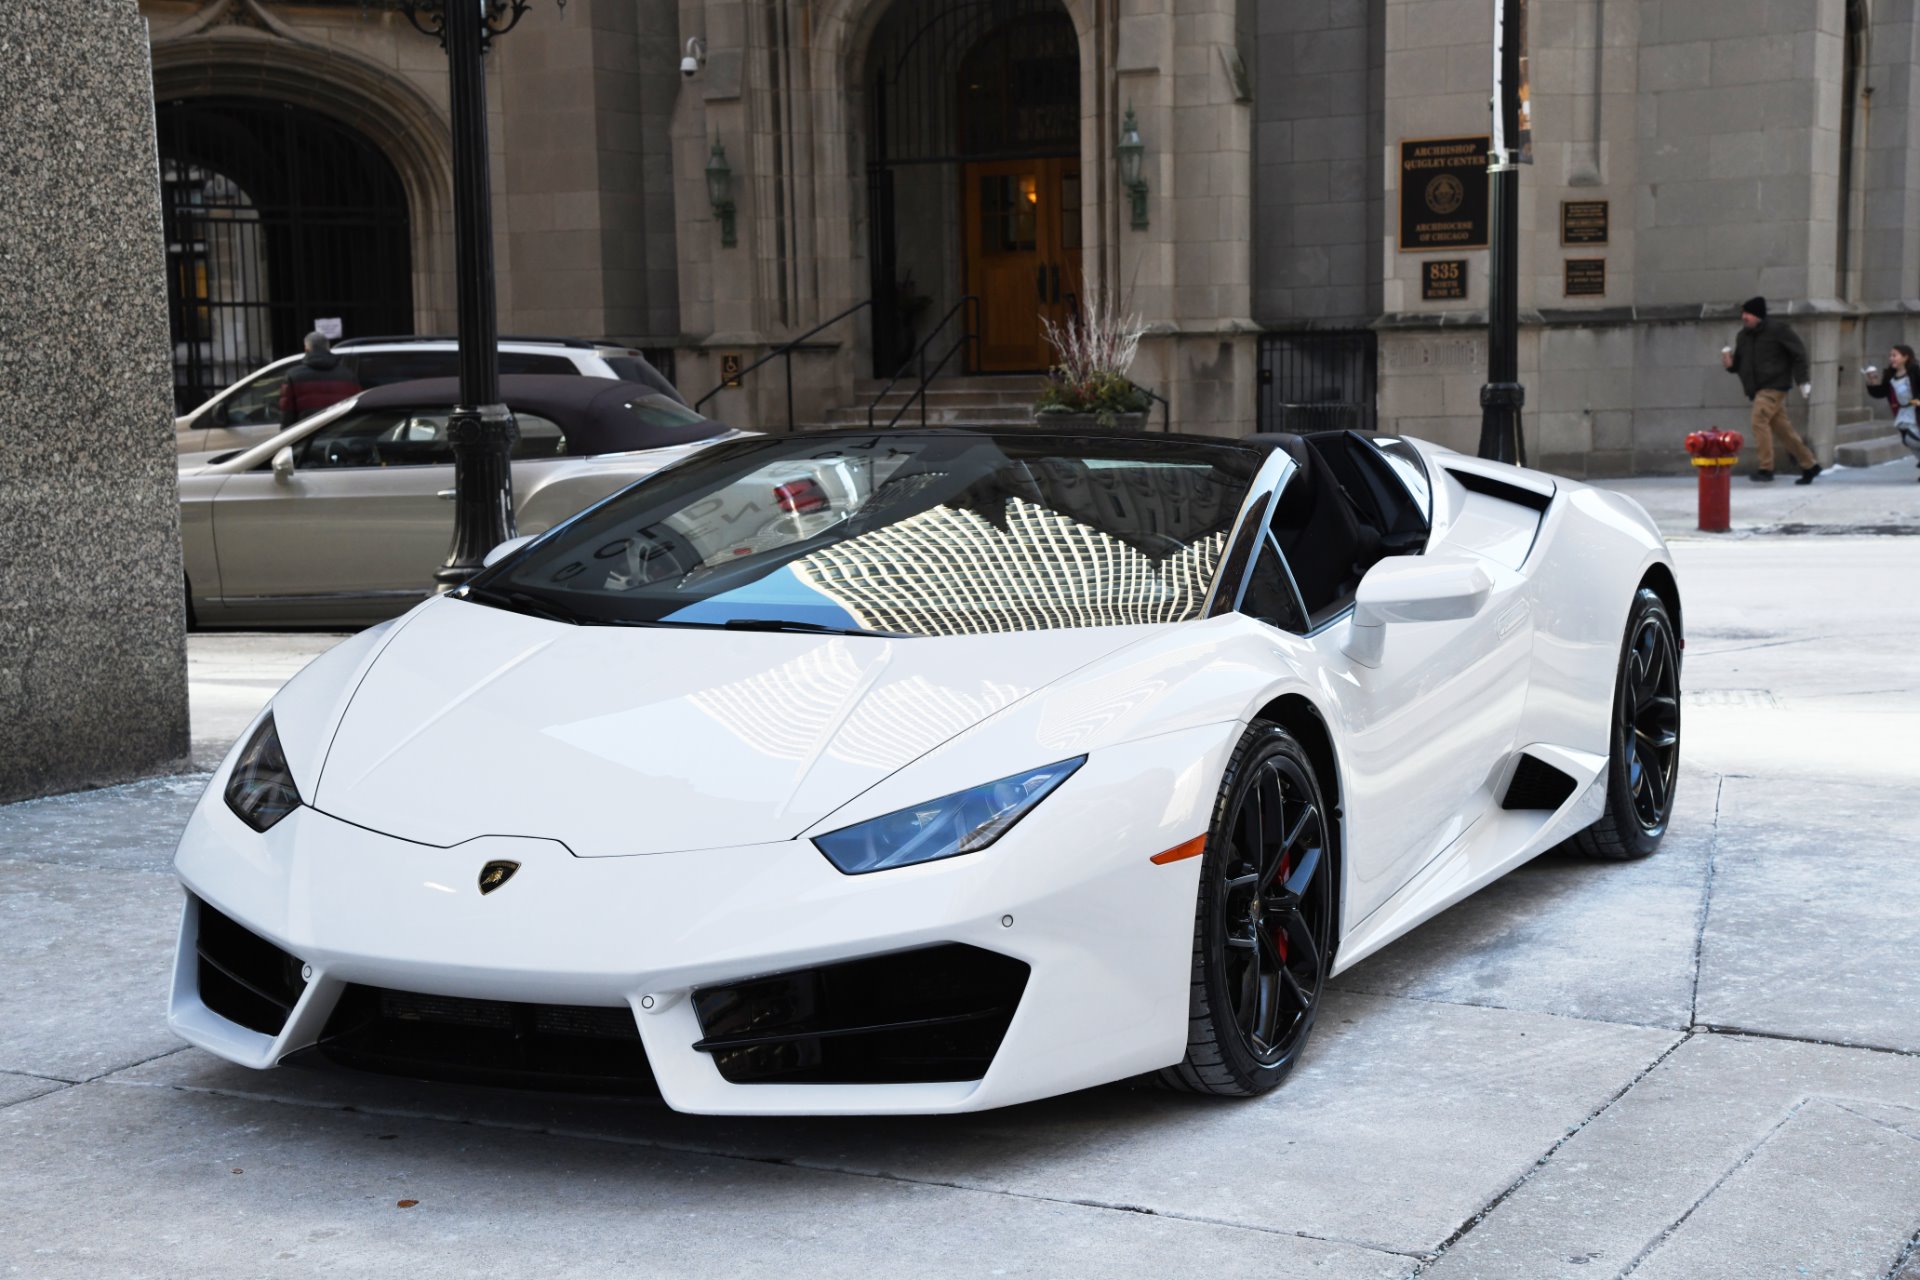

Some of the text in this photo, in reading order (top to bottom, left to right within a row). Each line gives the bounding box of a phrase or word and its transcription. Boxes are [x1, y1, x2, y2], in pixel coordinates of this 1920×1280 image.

[1414, 144, 1477, 157] ARCHBISHOP
[1404, 156, 1486, 170] QUIGLEY CENTER
[1415, 221, 1473, 232] ARCHDIOCESE
[1419, 232, 1469, 241] OF CHICAGO
[1430, 263, 1459, 280] 835
